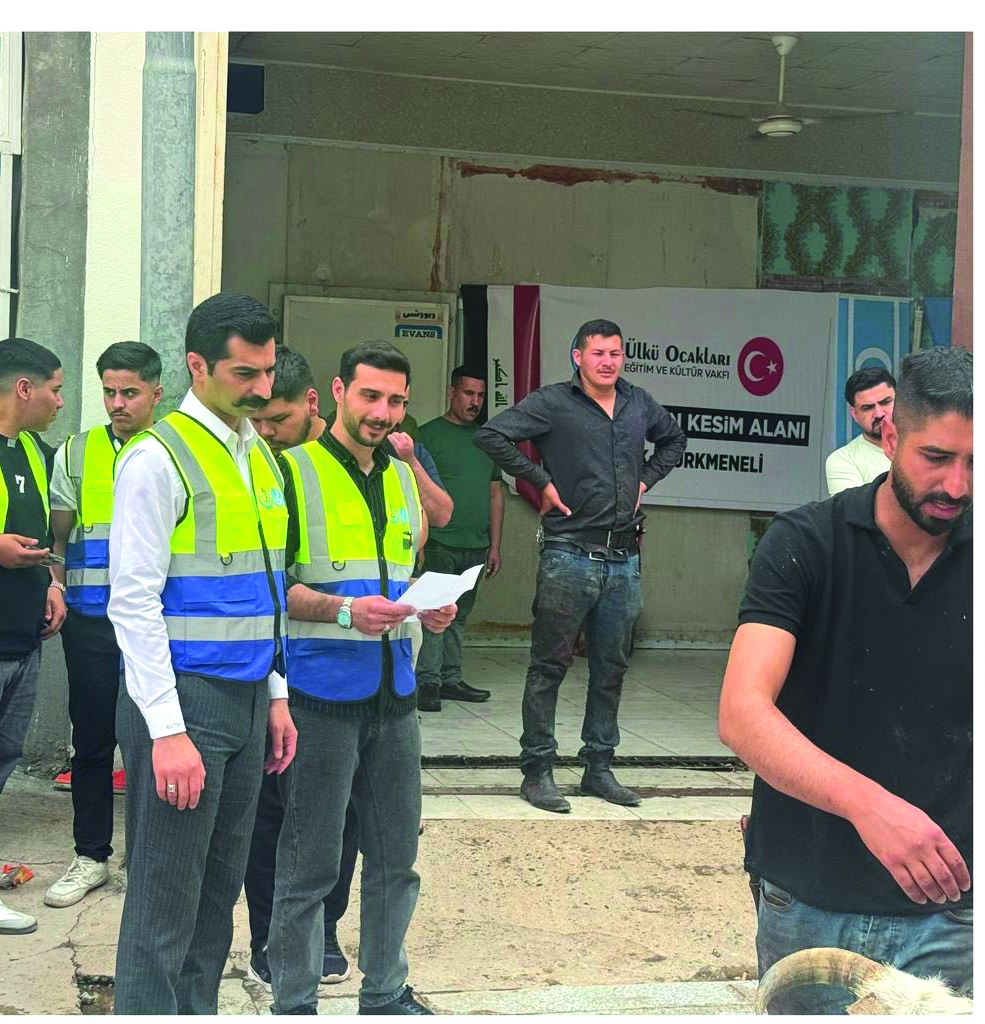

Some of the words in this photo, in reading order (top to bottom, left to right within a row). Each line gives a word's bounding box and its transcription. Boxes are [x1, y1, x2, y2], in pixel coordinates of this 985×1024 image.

[402, 330, 436, 338] EVANS
[625, 338, 660, 361] Ülkü
[624, 361, 654, 374] EĞİTİM
[656, 365, 668, 375] VE
[669, 365, 703, 378] KÜLTÜR
[704, 369, 730, 380] VAKFI
[748, 418, 806, 440] ALANI
[675, 452, 764, 474] RKMENELİ
[15, 474, 25, 493] 7
